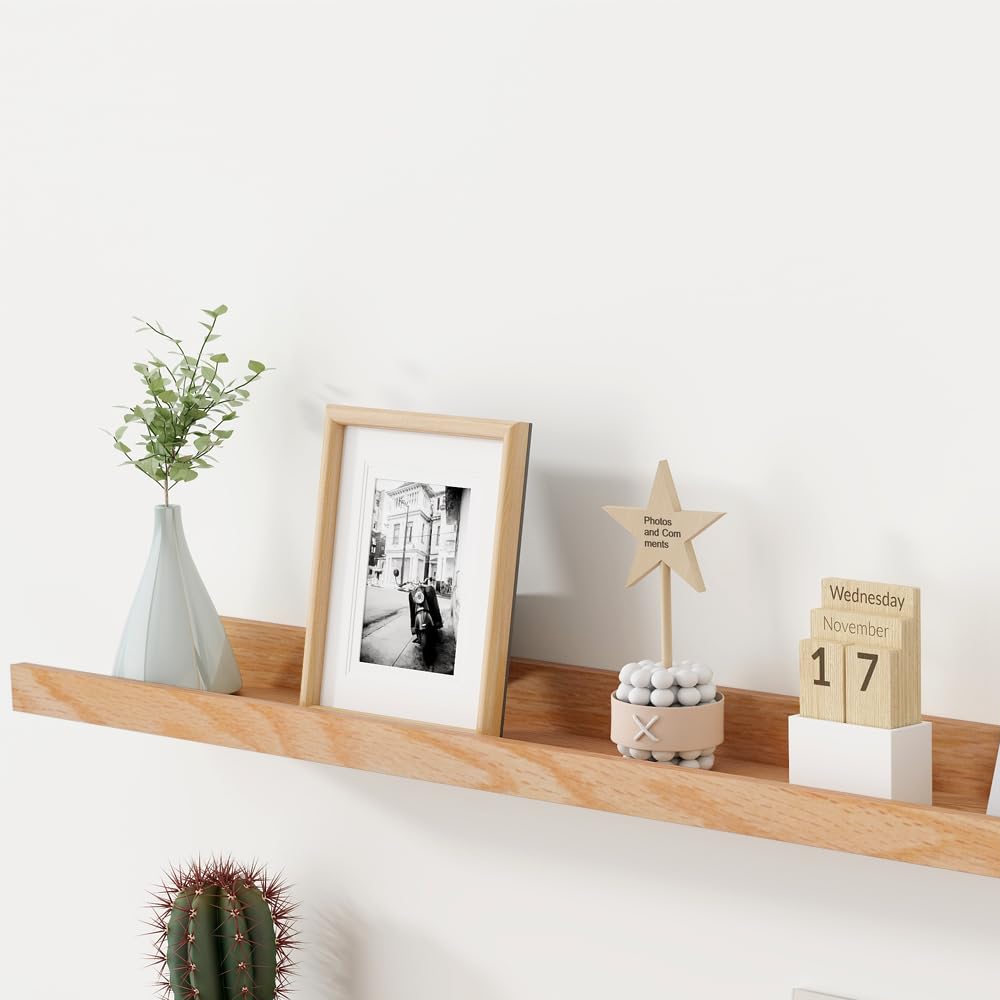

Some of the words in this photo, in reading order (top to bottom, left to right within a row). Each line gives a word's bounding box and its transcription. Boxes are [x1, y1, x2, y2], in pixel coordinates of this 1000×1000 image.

[643, 516, 673, 526] Photos
[643, 528, 660, 537] and
[644, 540, 670, 549] ments
[829, 584, 905, 612] Wednesday
[822, 616, 889, 639] November
